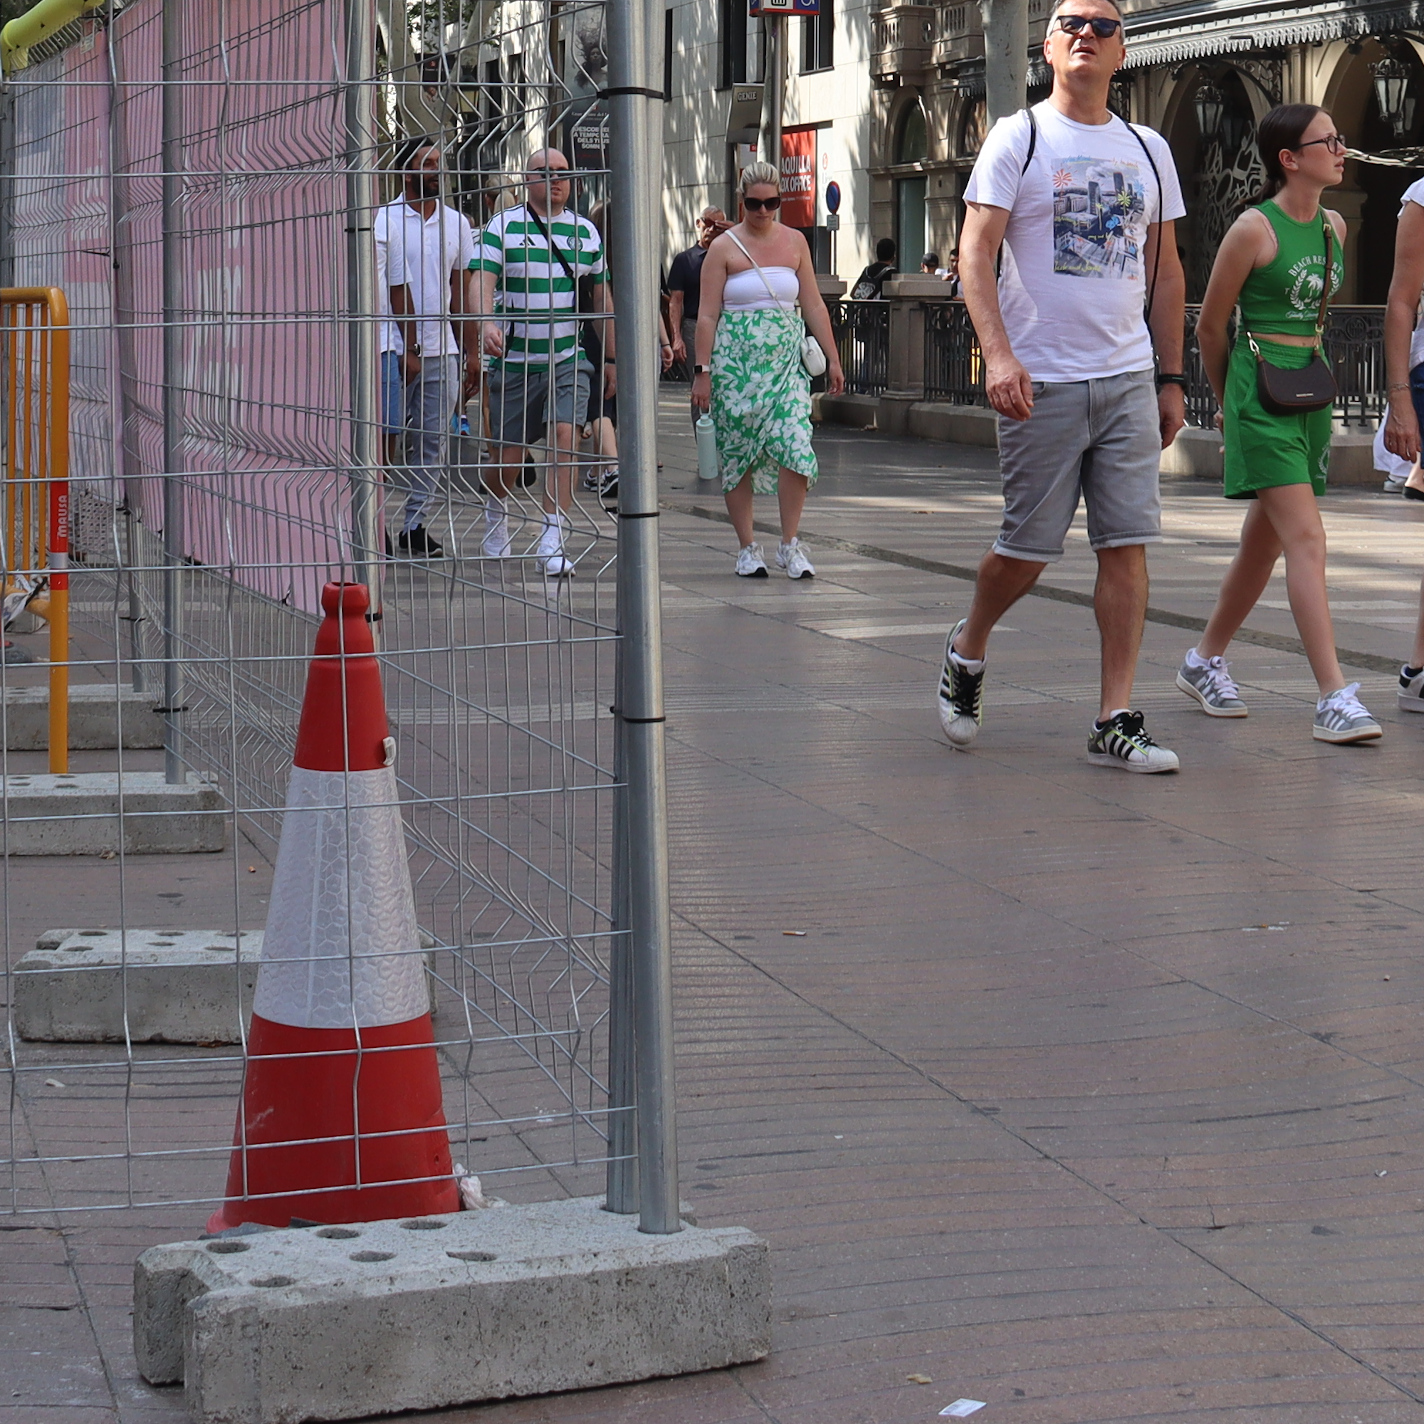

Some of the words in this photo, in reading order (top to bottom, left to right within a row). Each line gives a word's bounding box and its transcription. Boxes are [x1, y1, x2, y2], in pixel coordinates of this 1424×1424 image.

[737, 91, 757, 100] GENIE
[781, 154, 811, 174] AQUILLA
[1288, 255, 1312, 277] BEACH
[1312, 255, 1343, 274] RESRT
